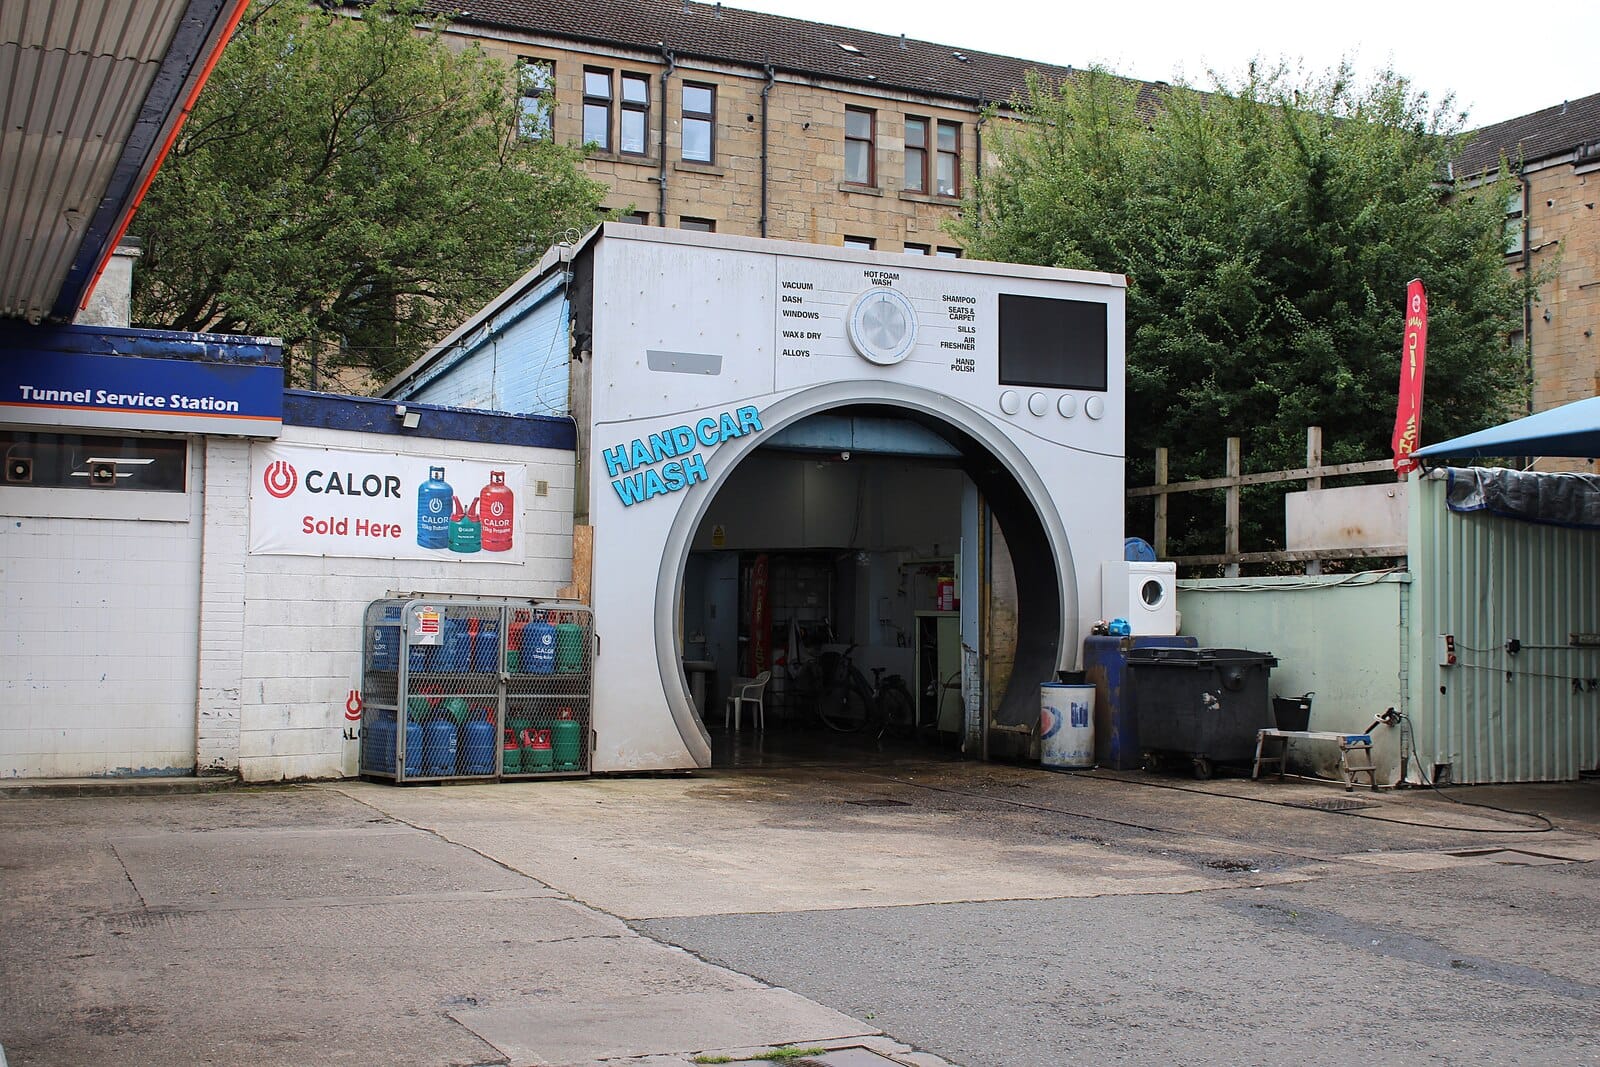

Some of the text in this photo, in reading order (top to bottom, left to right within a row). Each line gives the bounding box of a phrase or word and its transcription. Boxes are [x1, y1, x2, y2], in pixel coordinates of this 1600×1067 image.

[863, 270, 900, 281] HOT FOAM
[781, 281, 814, 290] VACUUM
[871, 279, 892, 287] WASH
[781, 295, 803, 304] DASH
[942, 294, 977, 304] SHAMPOO
[782, 309, 820, 320] WINDOWS
[948, 306, 970, 315] SEATS
[949, 313, 976, 322] CARPET
[957, 325, 976, 334] SILLS
[782, 330, 799, 339] WAX
[806, 332, 822, 340] DRY
[963, 336, 976, 344] AIR
[940, 341, 976, 351] FRESHNER
[782, 348, 811, 358] ALLOYS
[955, 357, 976, 366] HAND
[950, 364, 976, 373] POLISH
[19, 385, 240, 412] Tunnel Service Station
[602, 405, 764, 477] HAND CAR
[305, 470, 402, 499] CALOR
[611, 453, 709, 508] WASH
[421, 515, 449, 524] CALOR
[484, 518, 510, 527] CALOR
[302, 515, 402, 539] Sold Here
